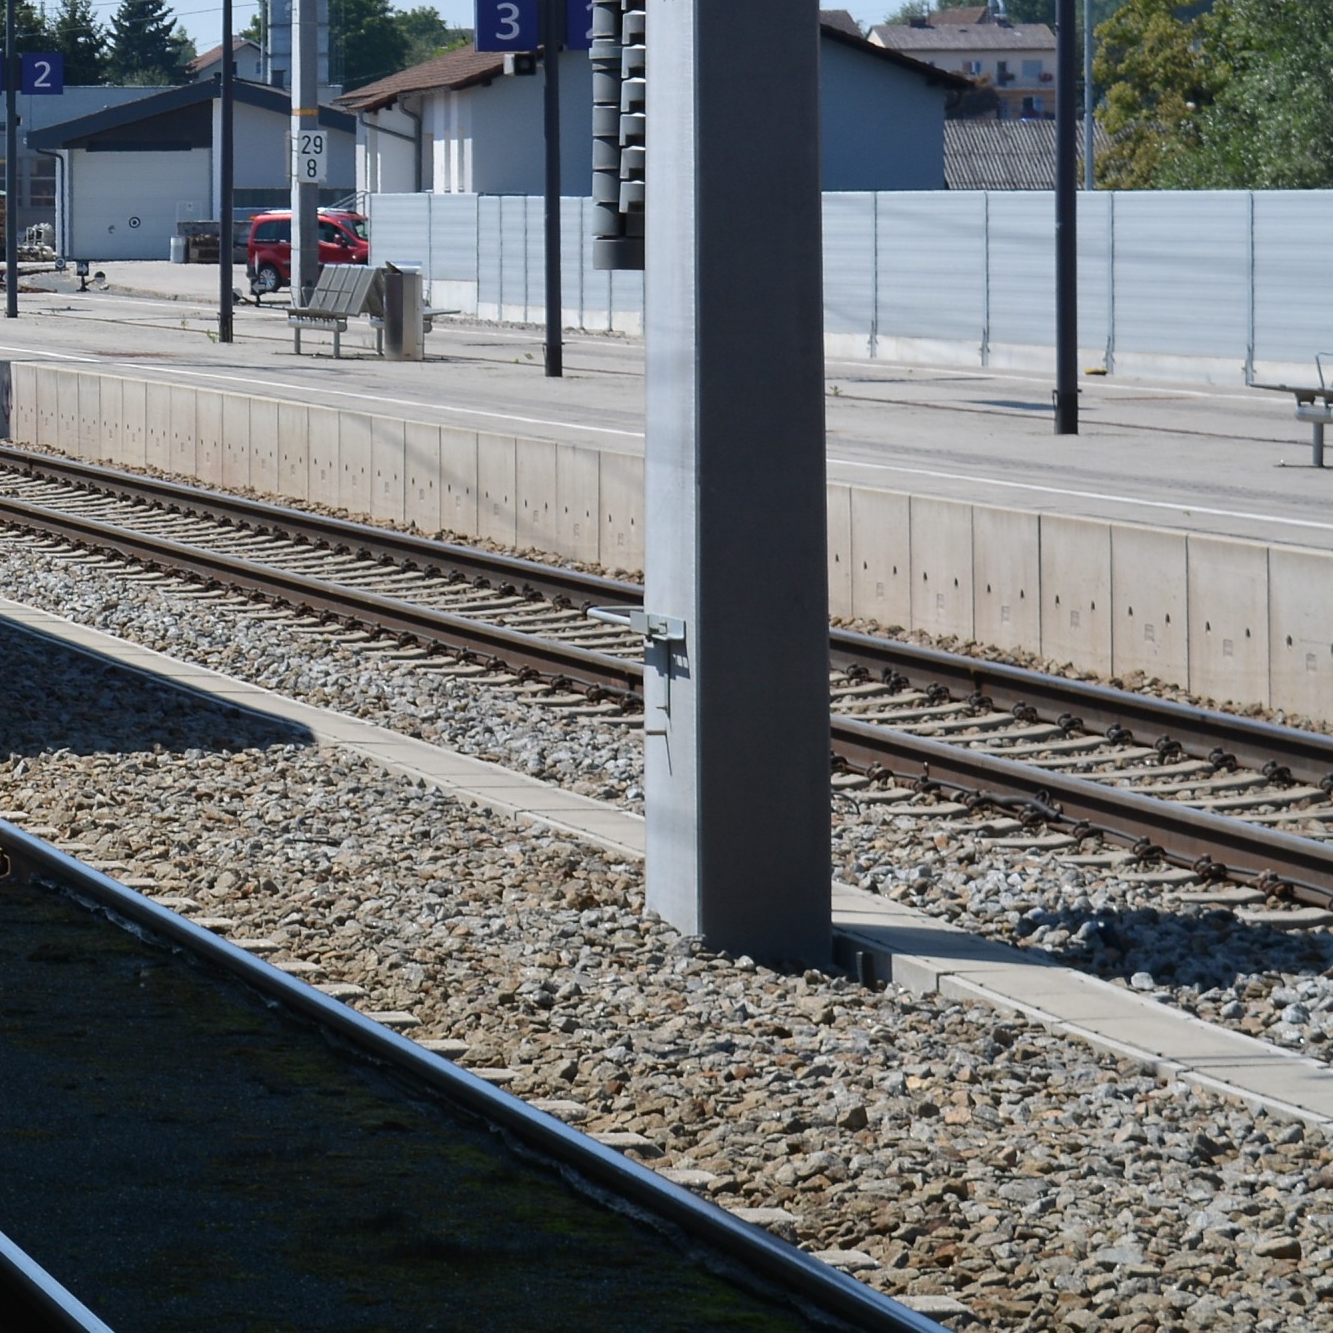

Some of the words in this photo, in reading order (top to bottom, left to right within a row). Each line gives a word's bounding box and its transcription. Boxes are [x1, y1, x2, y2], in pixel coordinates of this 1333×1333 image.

[495, 3, 520, 41] 3
[34, 61, 51, 87] 2
[301, 135, 323, 155] 29
[306, 159, 317, 178] 8
